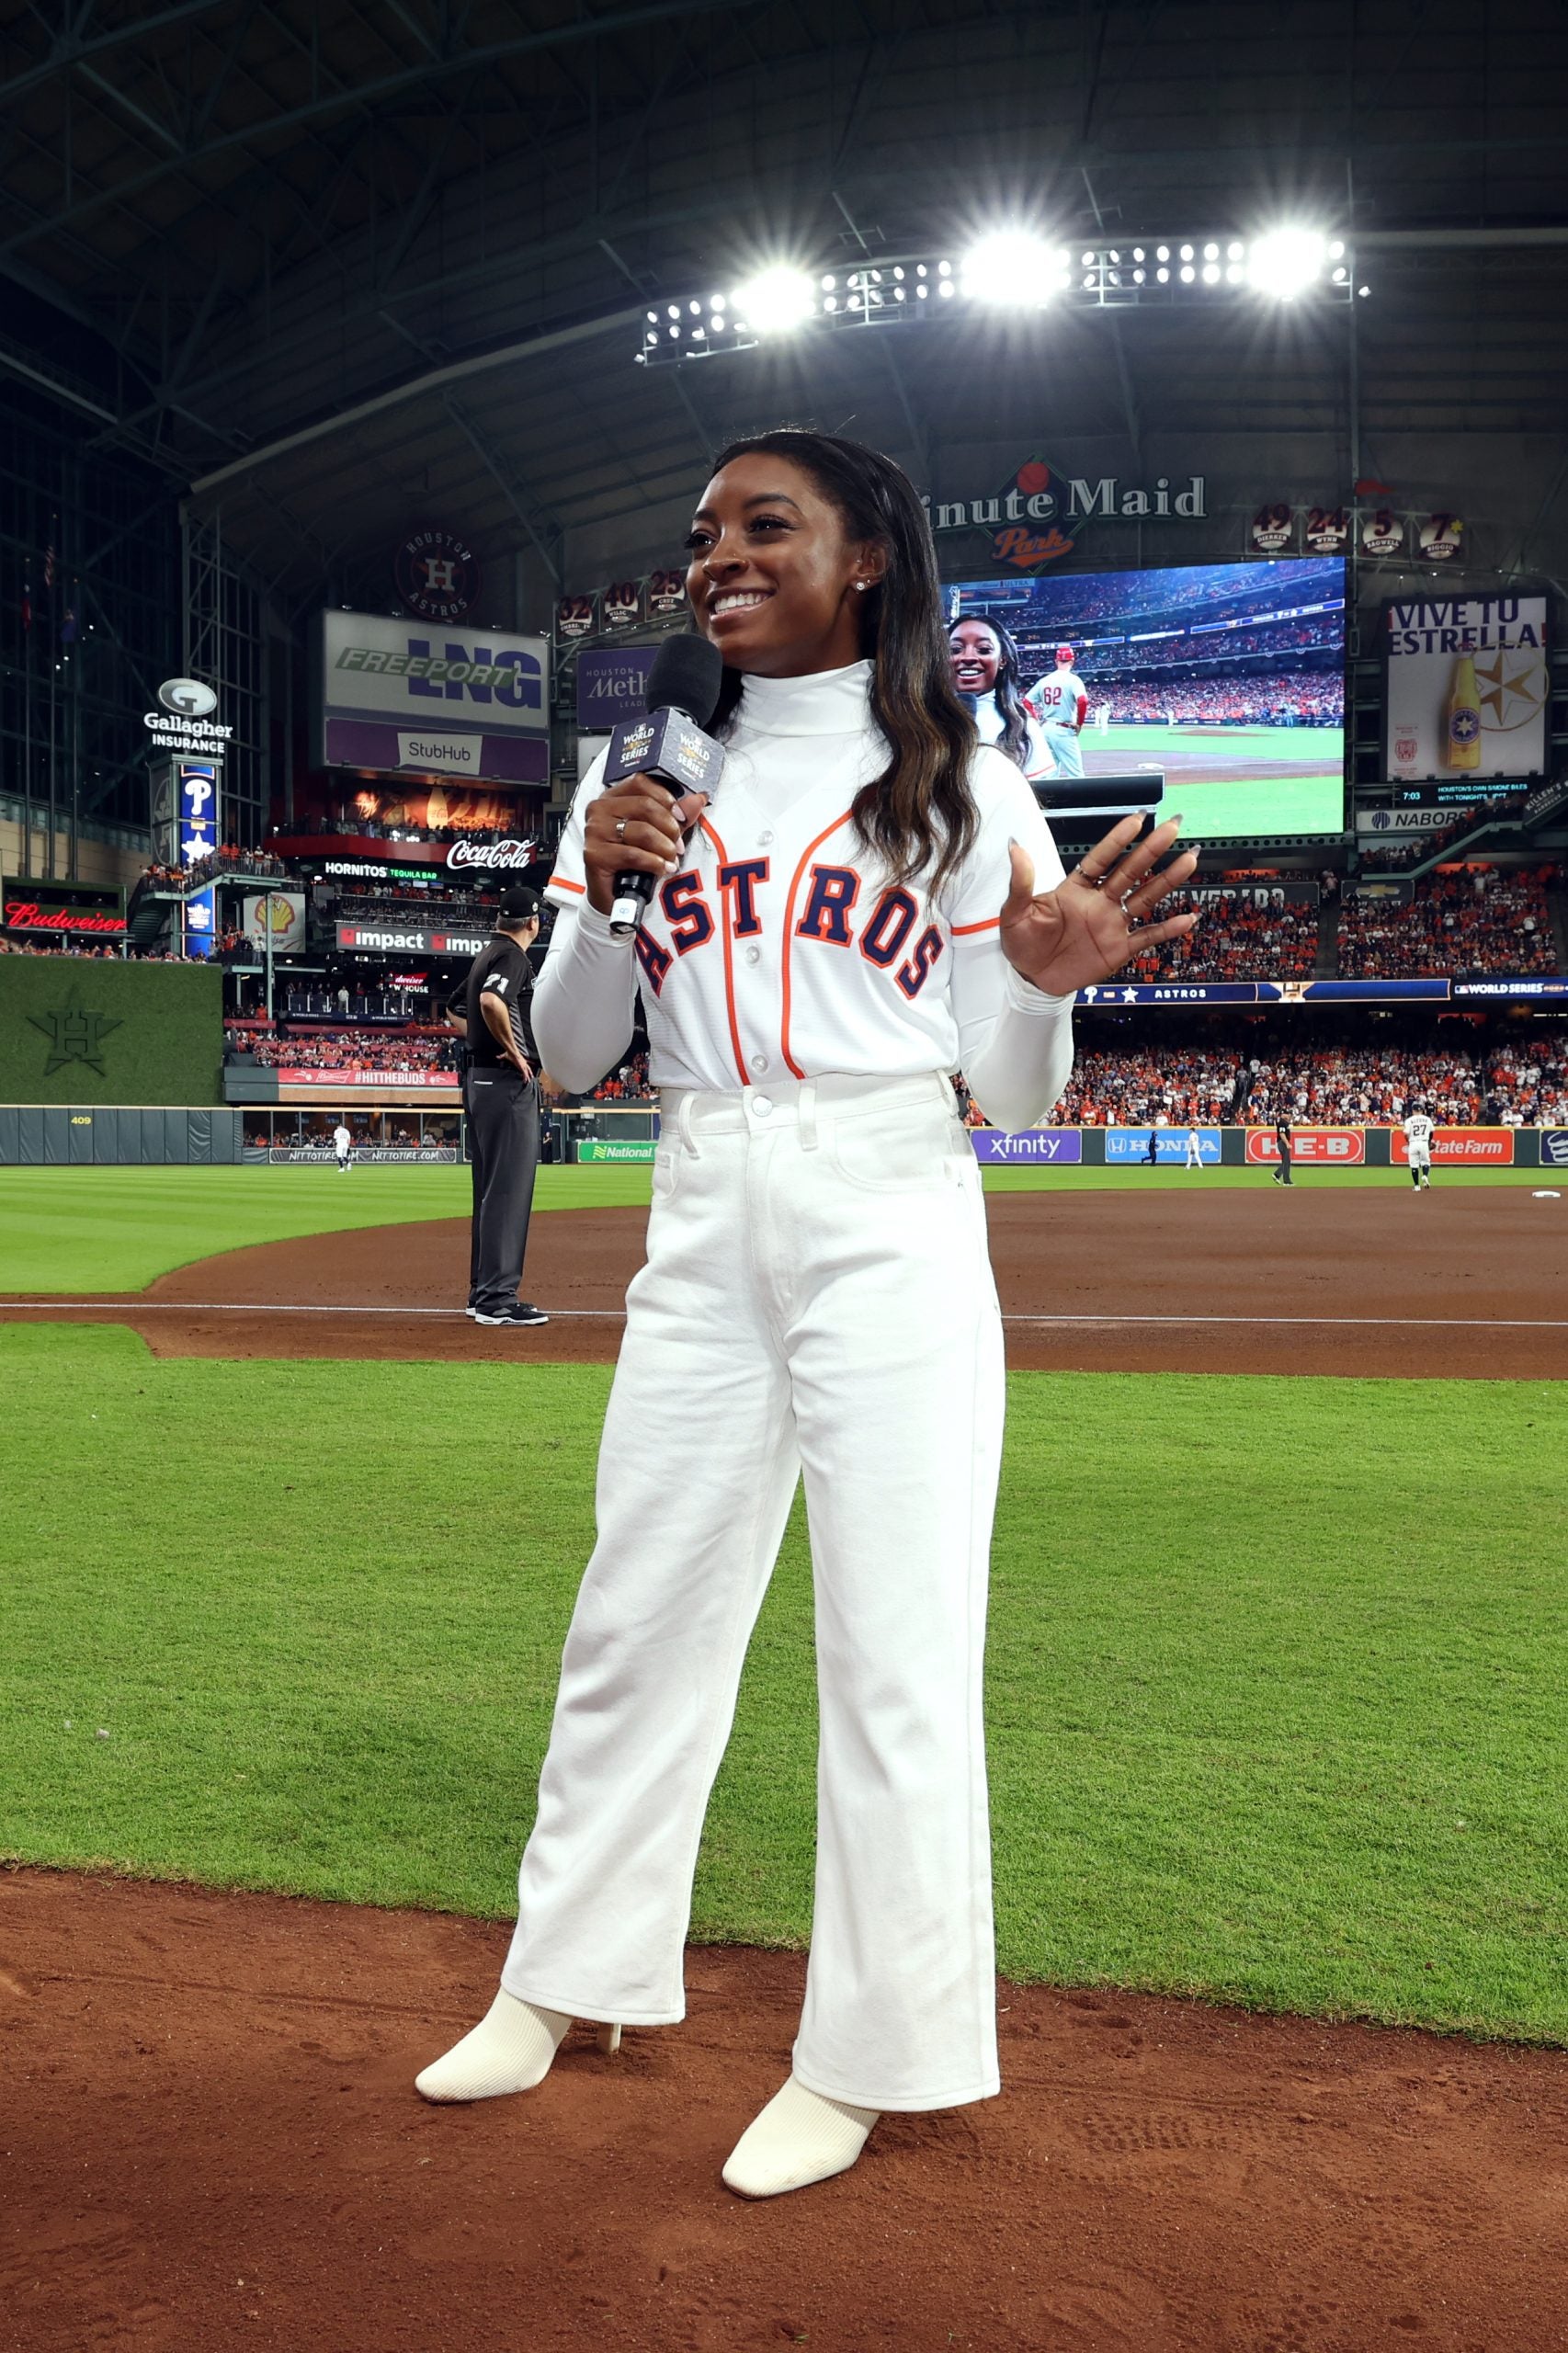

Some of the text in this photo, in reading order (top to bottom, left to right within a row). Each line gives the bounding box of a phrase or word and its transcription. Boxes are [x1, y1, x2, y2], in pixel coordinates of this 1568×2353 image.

[920, 477, 1208, 530] inute Maid
[1253, 504, 1290, 531] 49
[1308, 506, 1347, 534] 24
[1374, 508, 1392, 536] 5
[1432, 512, 1453, 541] 7
[405, 532, 472, 561] HOUSTON
[991, 527, 1068, 563] Park
[1315, 536, 1338, 544] WYNN
[1366, 540, 1400, 549] BAGWELL
[425, 557, 456, 591] H
[650, 570, 682, 596] 25
[409, 591, 468, 617] ASTROS
[604, 582, 636, 608] 40
[559, 596, 590, 621] 32
[1476, 598, 1519, 625] TU
[342, 648, 512, 687] FREEPORT
[408, 639, 541, 710] LNG
[586, 667, 634, 676] HOUSTON
[586, 671, 648, 699] Meth
[1043, 687, 1062, 706] 62
[619, 700, 646, 709] LEADI
[143, 712, 233, 738] Gallagher
[623, 727, 654, 745] WORLD
[153, 733, 225, 754] INSURANCE
[408, 742, 471, 761] StubHub
[619, 745, 649, 763] SERIES
[679, 733, 710, 761] WORLD
[676, 754, 705, 779] SERIES
[1403, 792, 1421, 801] 7:03
[447, 839, 536, 870] Coca-Cola
[325, 862, 437, 880] HORNITOS TEQUILA BAR
[5, 902, 127, 931] Budweiser
[634, 856, 945, 1000] ASTROS
[355, 930, 425, 949] impact
[395, 974, 424, 984] dweiser
[1468, 983, 1508, 994] WORLD
[1509, 983, 1544, 994] SERIES
[1154, 988, 1207, 999] ASTROS
[355, 1071, 426, 1085] #HITTHEBUDS
[71, 1116, 91, 1125] 409
[1413, 1124, 1426, 1136] 27
[290, 1150, 439, 1161] NITTOTIREM NITTOTIRE.COM
[606, 1146, 652, 1158] National
[990, 1133, 1061, 1159] xfinity
[1129, 1140, 1219, 1152] HONA
[1261, 1137, 1350, 1154] HE-B
